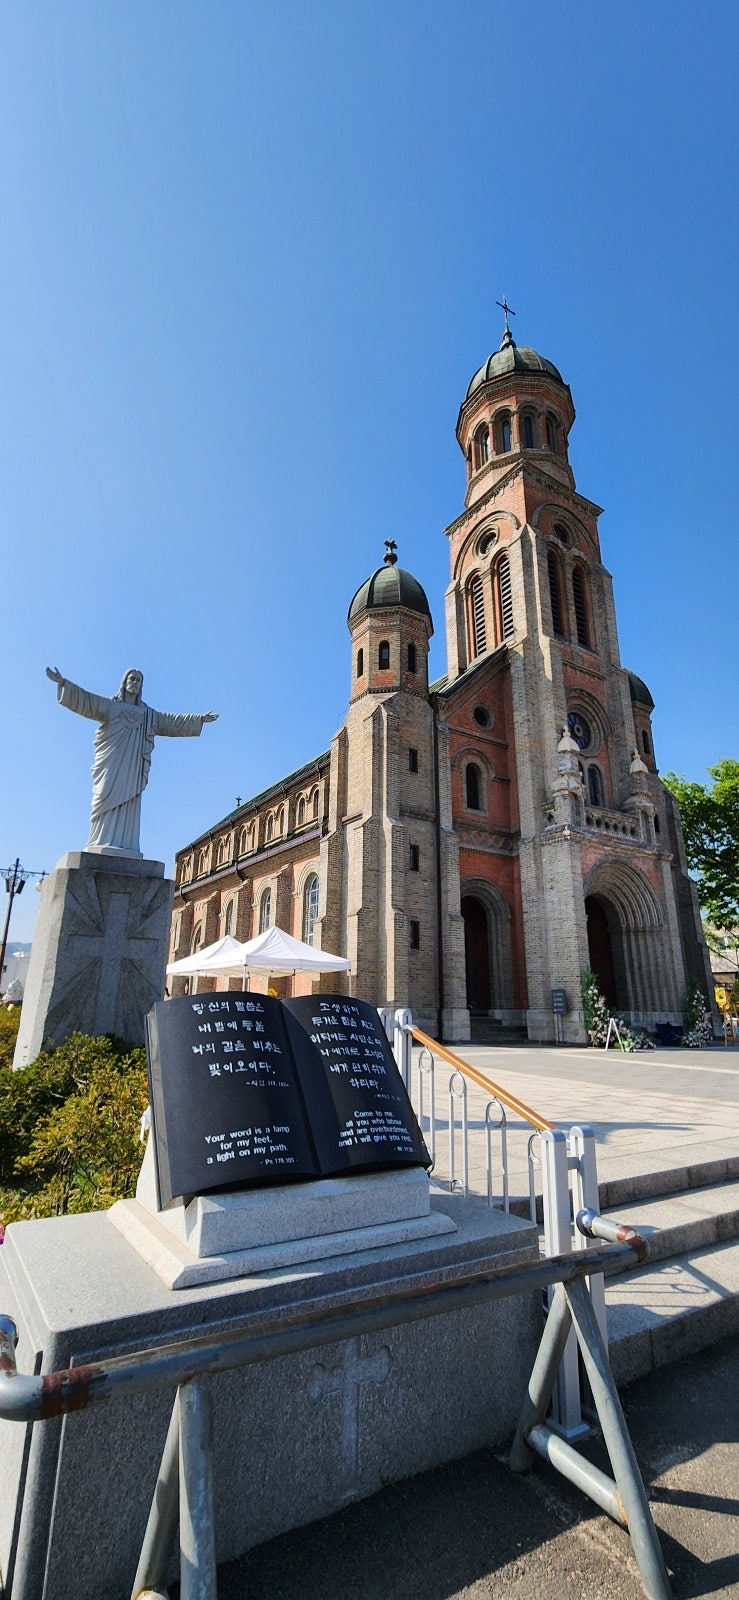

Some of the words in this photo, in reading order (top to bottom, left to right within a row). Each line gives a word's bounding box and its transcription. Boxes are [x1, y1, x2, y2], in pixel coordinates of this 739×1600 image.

[191, 1001, 230, 1015] 당신의
[234, 1001, 265, 1013] 말씀은
[197, 1022, 212, 1033] 내
[214, 1020, 238, 1033] 발에
[311, 1016, 339, 1027] 무거운
[309, 1032, 348, 1044] 허덕이는
[191, 1042, 216, 1055] 나의
[221, 1040, 247, 1053] 길을
[252, 1040, 282, 1054] 비추는
[208, 1060, 276, 1077] 빛이오이다.
[329, 1063, 349, 1074] 내가
[353, 1110, 374, 1118] Come
[345, 1120, 354, 1128] all
[356, 1119, 370, 1127] you
[204, 1133, 226, 1144] Your
[229, 1128, 252, 1139] word
[254, 1126, 262, 1135] is
[273, 1125, 290, 1134] lamp
[339, 1129, 354, 1138] and
[356, 1127, 368, 1135] are
[219, 1142, 233, 1151] for
[236, 1139, 250, 1147] my
[338, 1138, 353, 1148] and
[360, 1134, 372, 1143] will
[373, 1134, 387, 1142] give
[389, 1134, 400, 1142] you
[206, 1156, 213, 1165] a
[216, 1150, 235, 1162] light
[238, 1149, 251, 1157] on
[253, 1146, 266, 1155] my
[269, 1144, 288, 1153] path.
